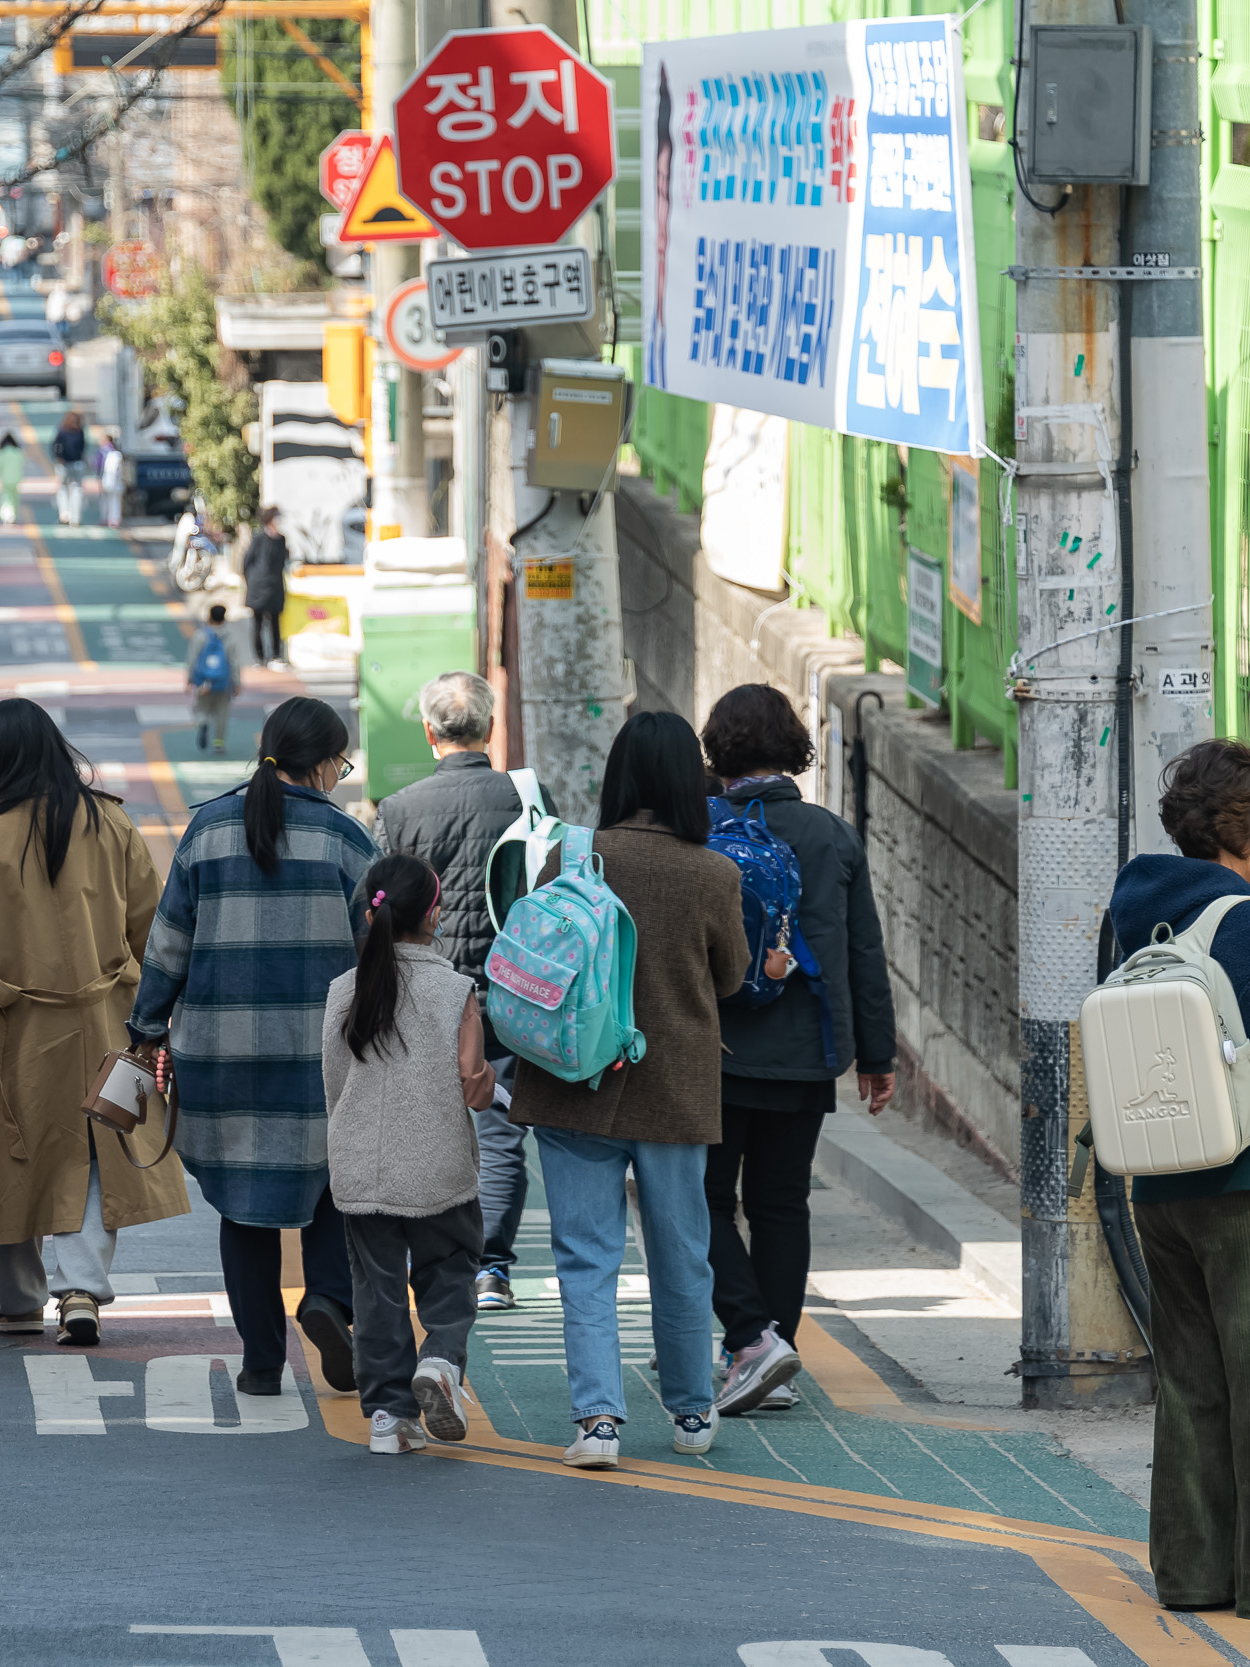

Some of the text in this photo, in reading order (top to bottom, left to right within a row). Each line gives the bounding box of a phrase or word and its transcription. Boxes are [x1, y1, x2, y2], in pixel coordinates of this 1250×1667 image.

[424, 59, 580, 142] 정지
[430, 154, 583, 219] STOP
[435, 259, 584, 316] 어린이보호구역
[1181, 672, 1210, 687] 과외
[499, 964, 551, 999] THE NORTH FACE
[1125, 1103, 1190, 1122] KANGOL
